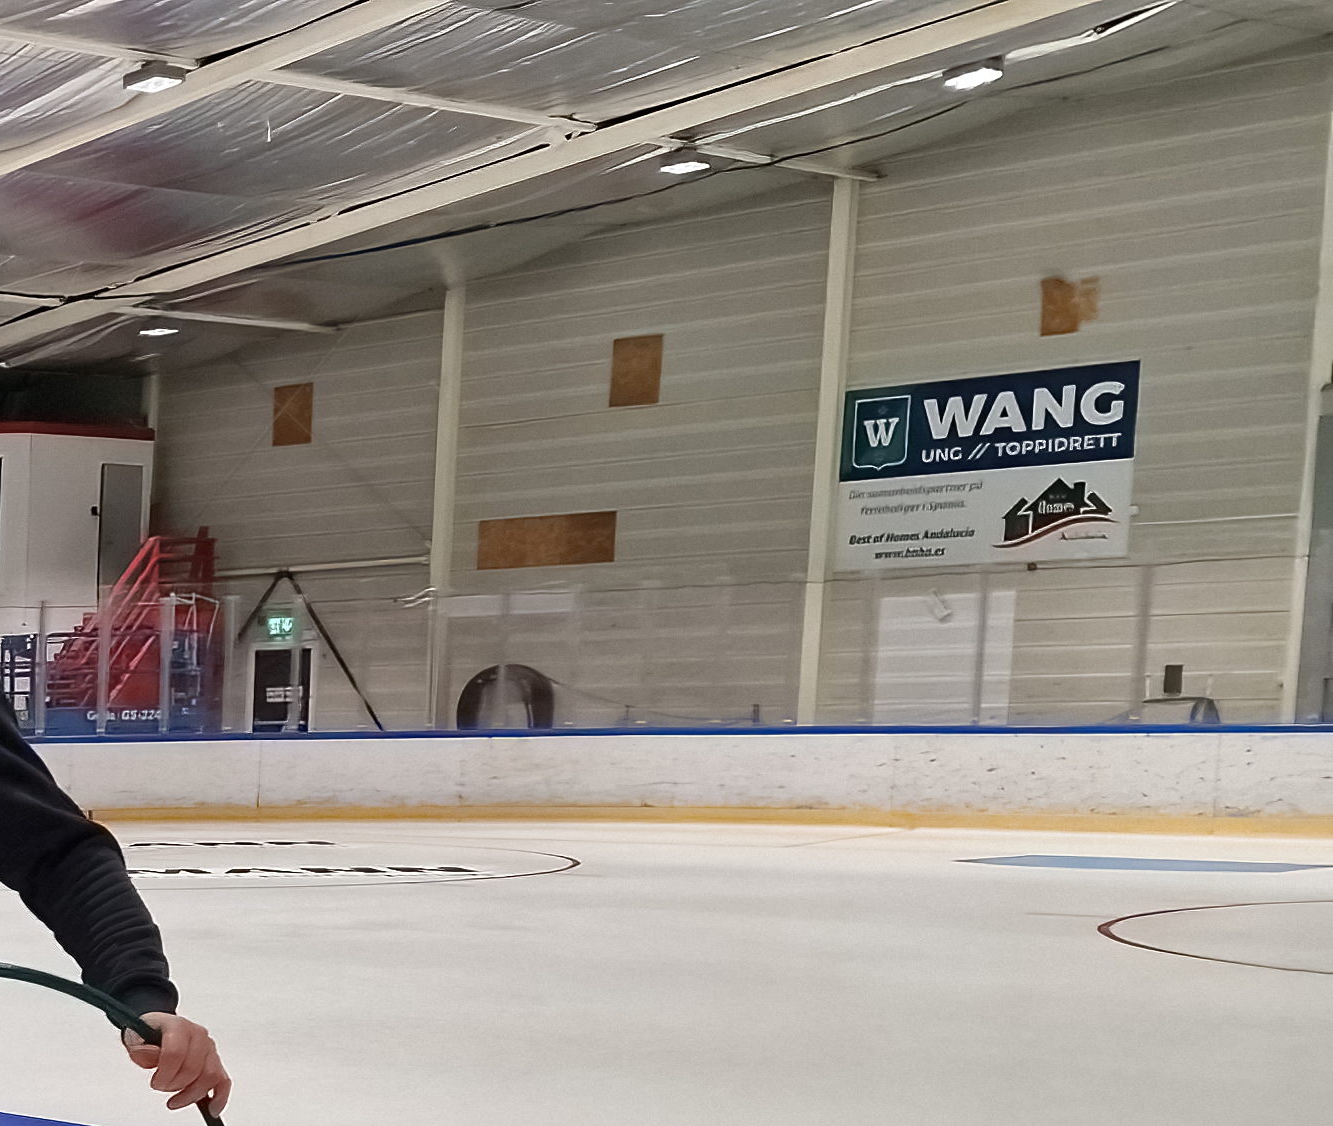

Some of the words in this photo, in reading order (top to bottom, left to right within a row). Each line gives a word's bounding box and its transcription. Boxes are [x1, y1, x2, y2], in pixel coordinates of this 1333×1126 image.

[923, 381, 1125, 439] WANG
[864, 417, 899, 447] W
[922, 447, 962, 463] UNG
[995, 433, 1122, 457] TOPPIDRETT
[849, 535, 871, 545] Best
[873, 533, 885, 543] of
[885, 532, 920, 542] Homes
